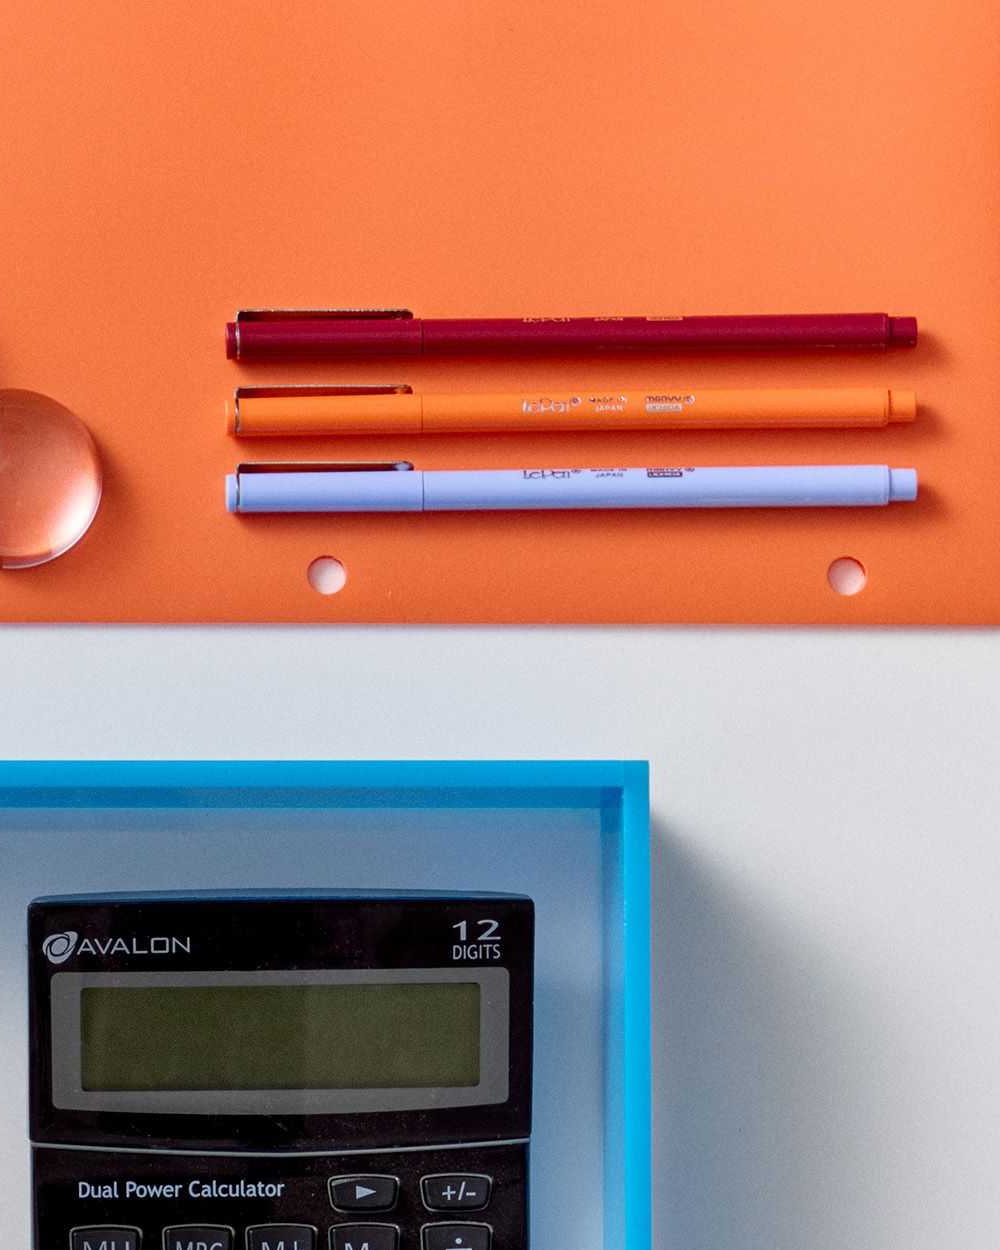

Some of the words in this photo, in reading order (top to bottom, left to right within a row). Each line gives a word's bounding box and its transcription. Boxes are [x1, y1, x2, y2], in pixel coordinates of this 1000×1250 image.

[452, 919, 502, 941] 12
[76, 935, 191, 956] AVALON
[452, 944, 502, 961] DIGITS
[78, 1180, 119, 1199] Dual
[125, 1180, 183, 1198] Power
[188, 1179, 285, 1198] Calculator
